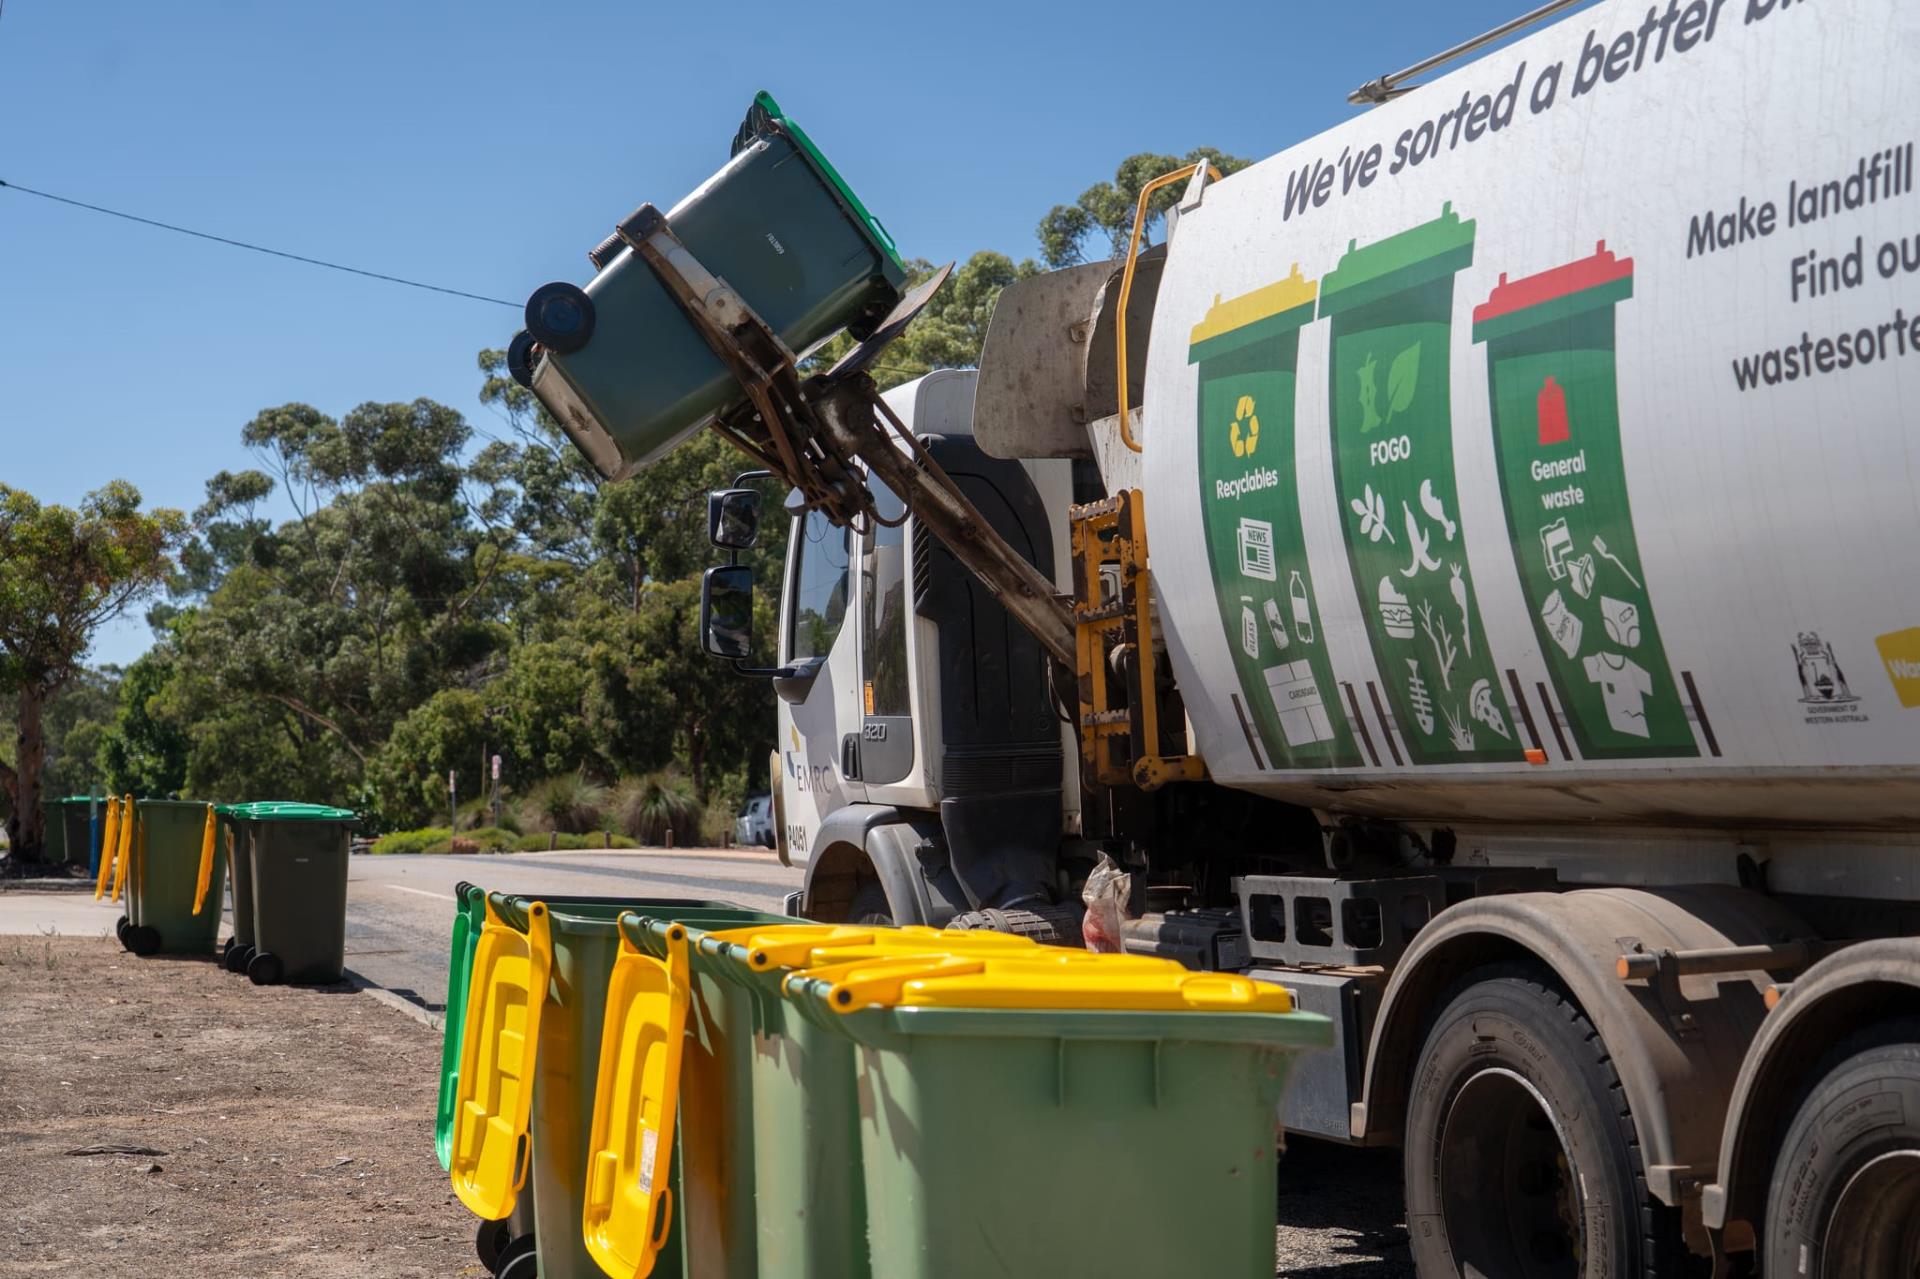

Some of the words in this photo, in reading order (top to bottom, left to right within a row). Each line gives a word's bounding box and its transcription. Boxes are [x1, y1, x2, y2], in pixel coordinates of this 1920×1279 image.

[1283, 145, 1383, 222] We've
[1389, 61, 1527, 176] sorted
[1529, 60, 1564, 115] a
[1571, 0, 1727, 99] better
[1685, 196, 1778, 260] Make
[1788, 141, 1914, 229] landfill
[1791, 235, 1864, 303] Find
[1369, 435, 1412, 466] FOGO
[1531, 448, 1586, 481] General
[1215, 466, 1279, 501] Recyclables
[1541, 484, 1585, 510] waste
[1247, 529, 1268, 543] NEWS
[864, 723, 888, 741] 320
[796, 764, 832, 795] EMRC
